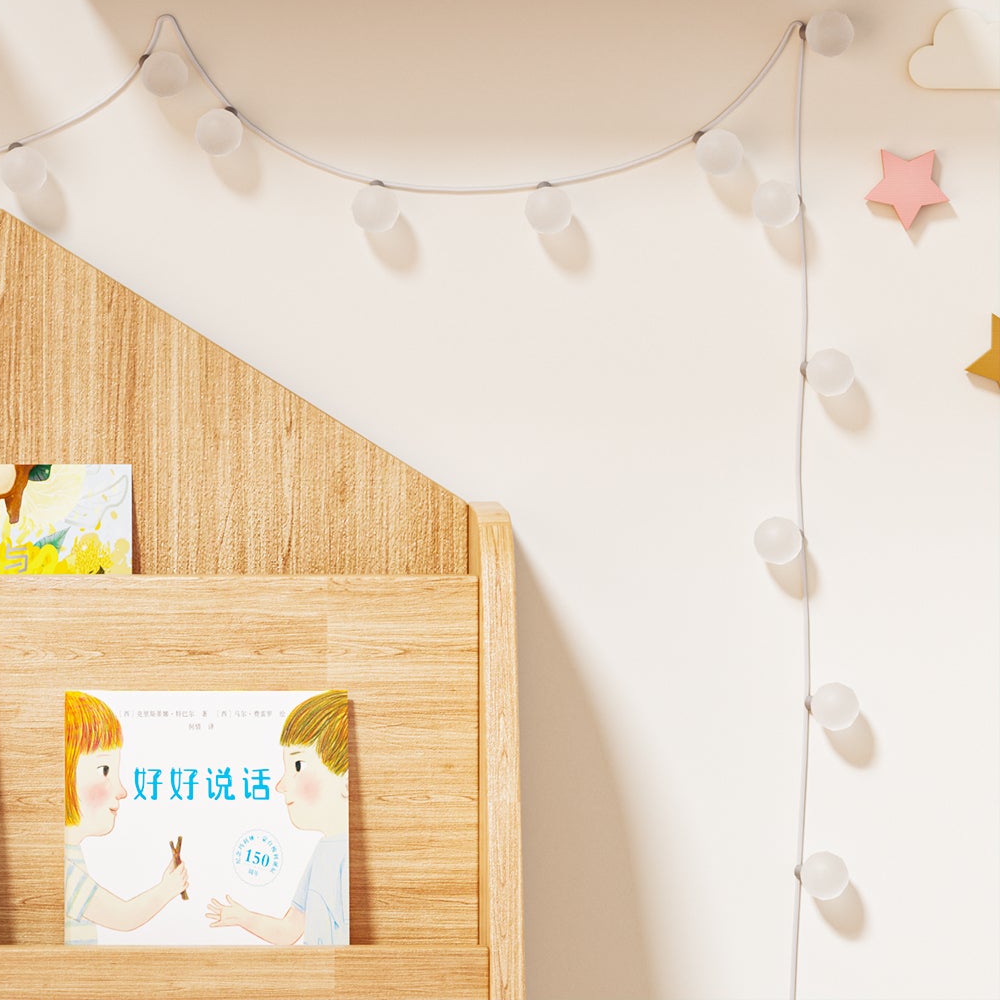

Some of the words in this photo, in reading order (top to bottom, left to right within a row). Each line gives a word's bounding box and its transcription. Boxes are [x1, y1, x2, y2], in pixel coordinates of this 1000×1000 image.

[133, 767, 271, 800] 好好说话
[245, 848, 270, 868] 150
